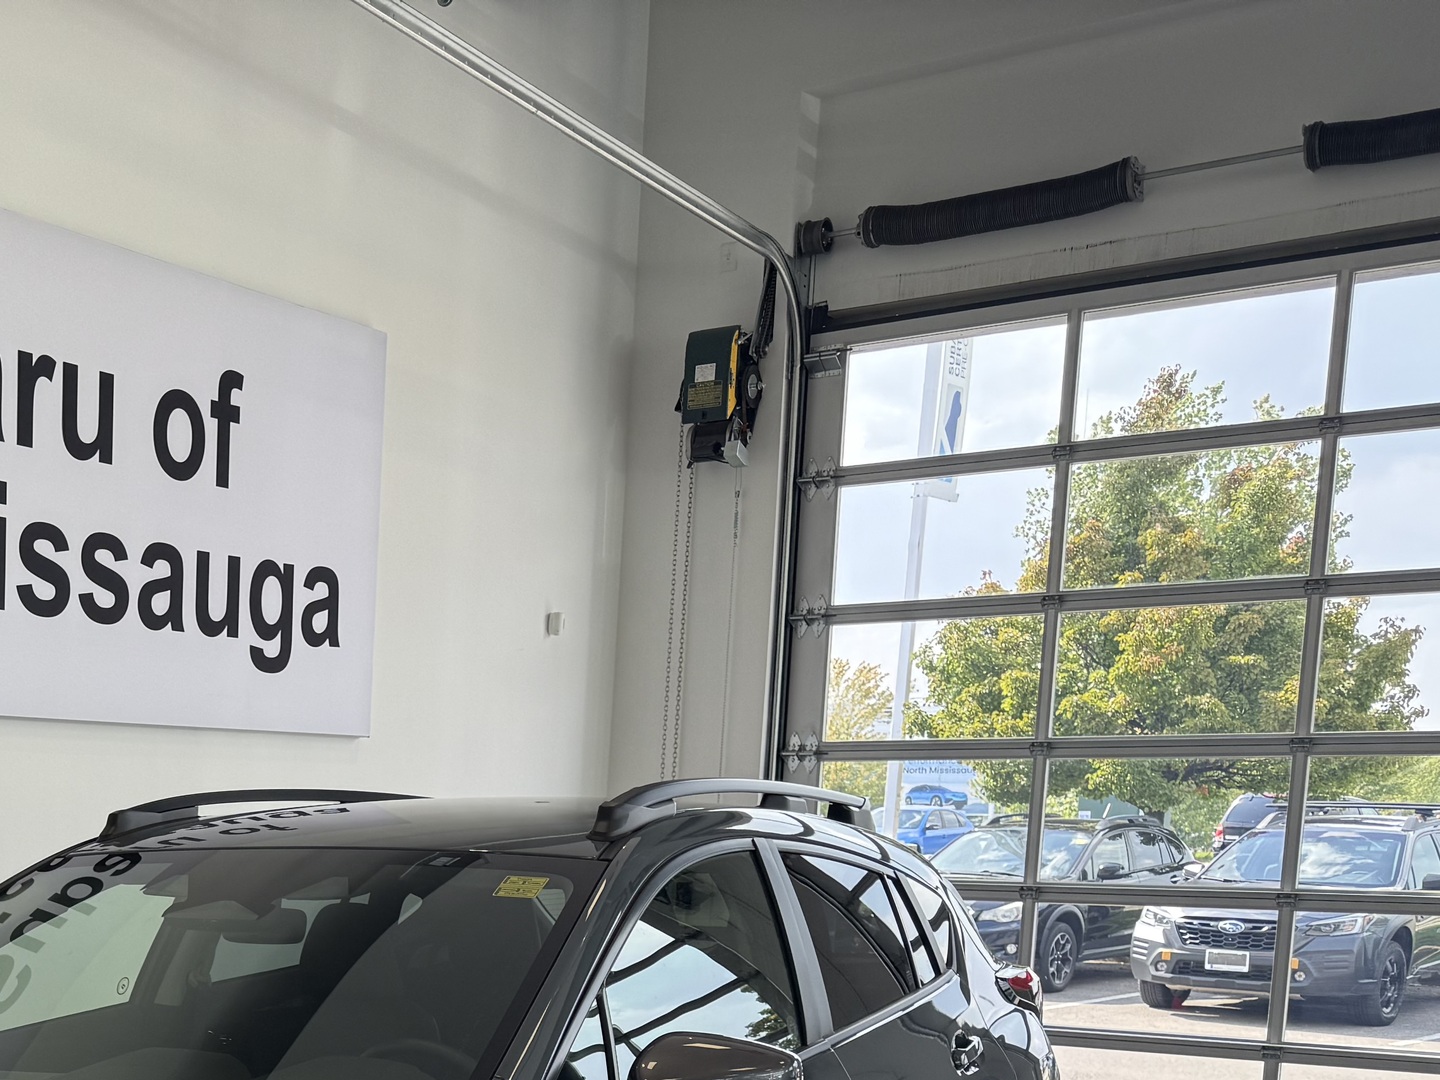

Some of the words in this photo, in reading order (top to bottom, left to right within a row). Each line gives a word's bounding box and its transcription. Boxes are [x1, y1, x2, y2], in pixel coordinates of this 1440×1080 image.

[153, 369, 245, 489] of
[903, 766, 927, 774] North
[929, 766, 976, 777] Mississau
